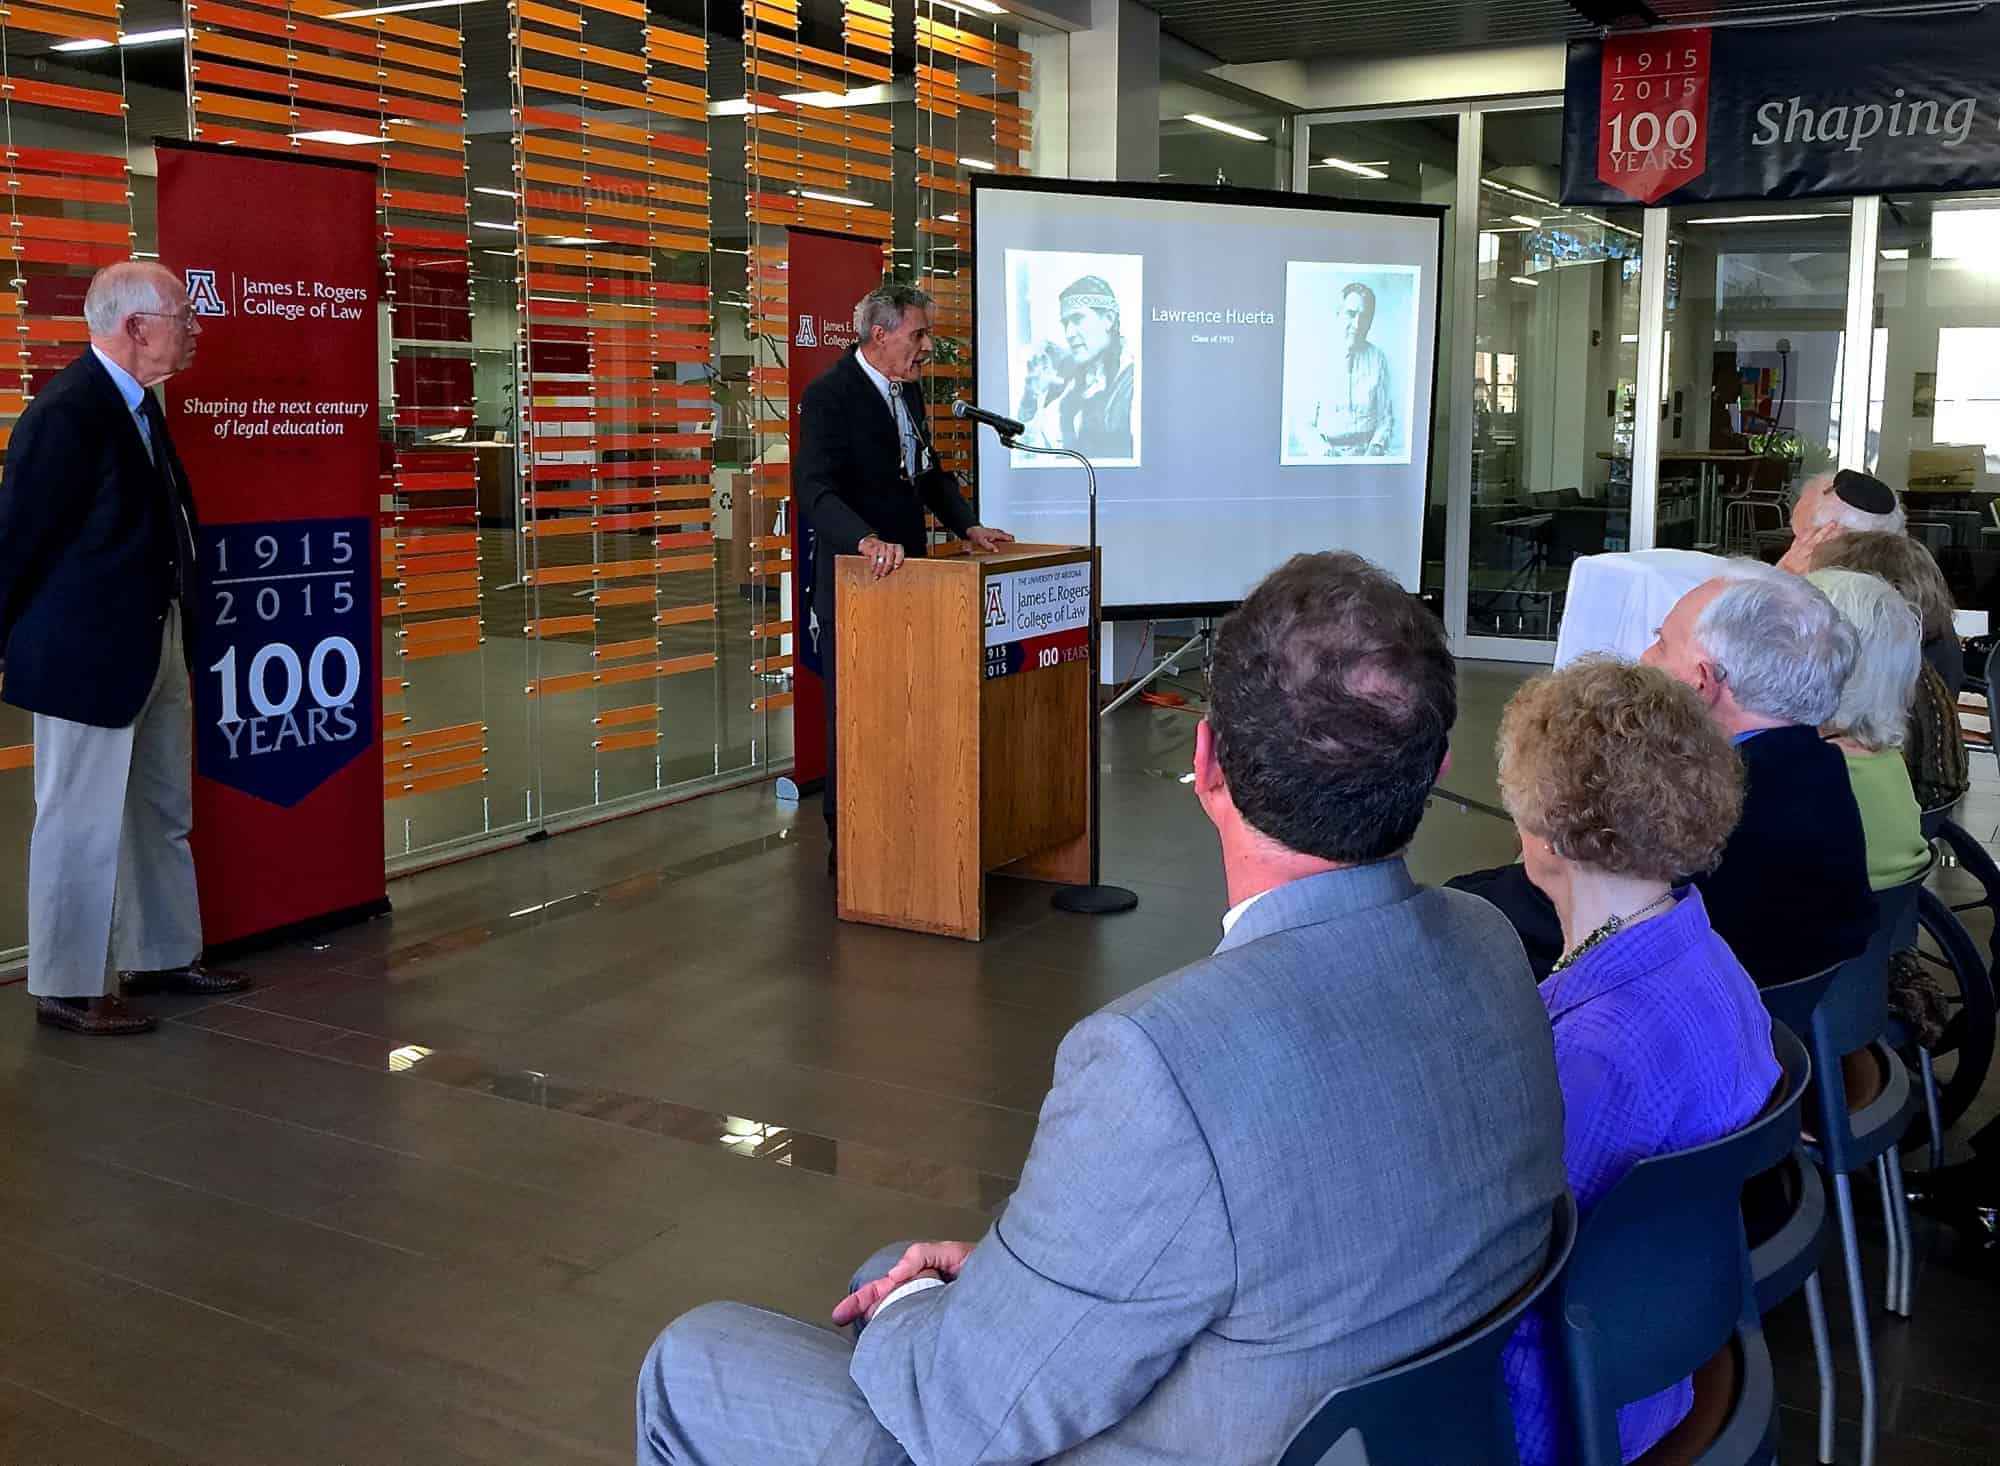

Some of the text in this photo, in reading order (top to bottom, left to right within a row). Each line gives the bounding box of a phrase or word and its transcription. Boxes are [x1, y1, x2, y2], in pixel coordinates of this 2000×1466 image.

[1607, 109, 1697, 152] 100
[1752, 88, 1977, 152] Shaping
[1608, 148, 1694, 173] YEARS
[243, 277, 368, 303] James E. Rogers
[243, 298, 362, 320] College of Law
[1151, 306, 1274, 325] Lawrence Huerta
[823, 319, 845, 333] James
[823, 334, 850, 350] College
[183, 398, 368, 418] Shaping the next century
[214, 419, 344, 439] of legal education
[1017, 584, 1089, 613] James E. Rogers
[1017, 605, 1086, 631] College of Law
[986, 645, 1007, 660] 915
[1038, 644, 1089, 668] 100 YEARS
[210, 636, 361, 724] 100
[985, 662, 1007, 677] 015
[216, 703, 358, 759] YEARS
